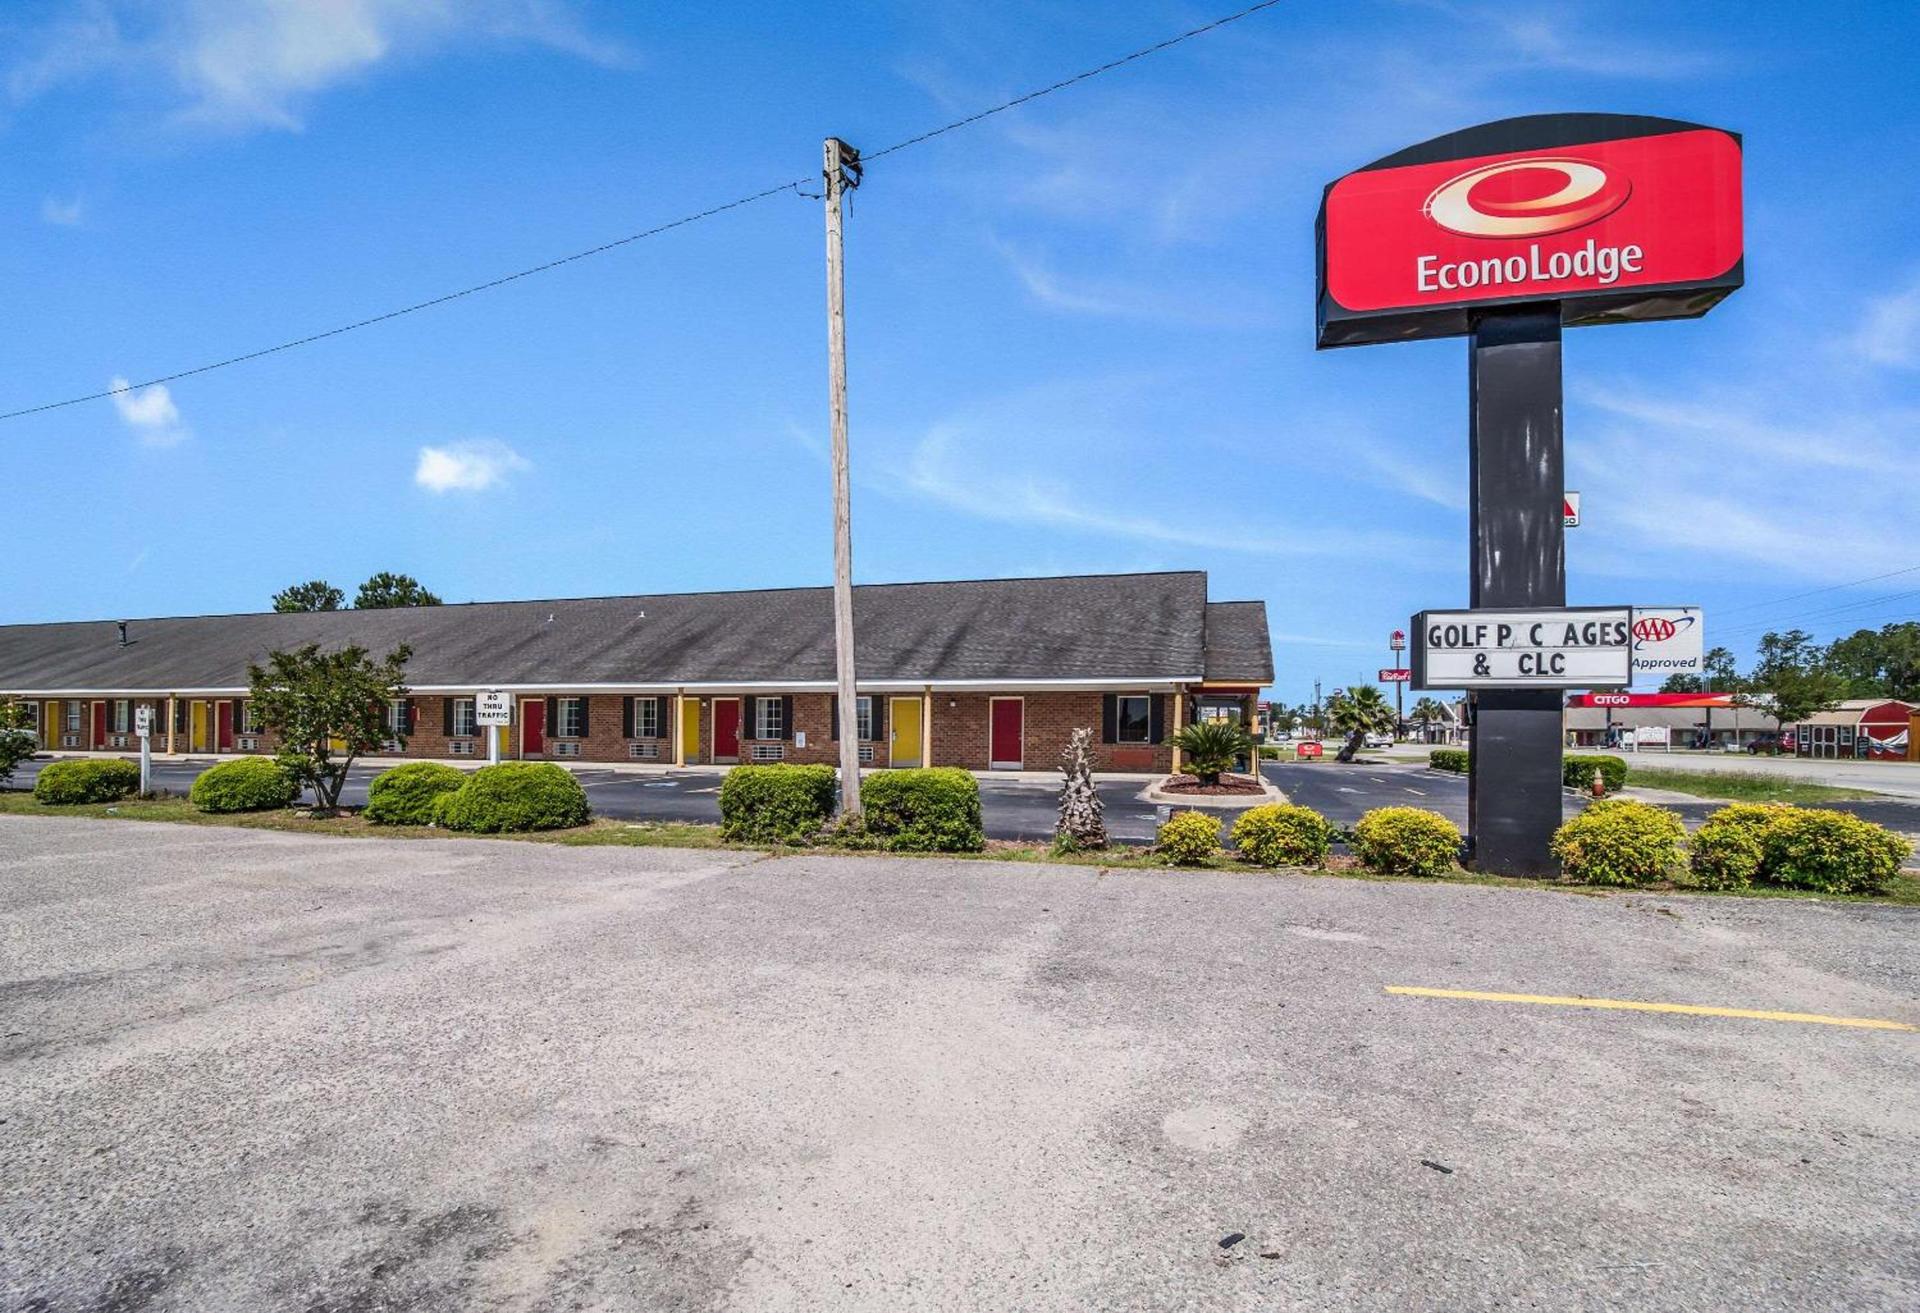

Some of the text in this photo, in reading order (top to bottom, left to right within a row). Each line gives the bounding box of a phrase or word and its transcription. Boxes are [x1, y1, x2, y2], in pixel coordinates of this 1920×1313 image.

[1428, 624, 1487, 647] GOLF
[1635, 618, 1673, 641] AAA
[1472, 652, 1565, 675] & CLC
[1632, 657, 1697, 670] Approved
[1594, 695, 1629, 705] CITGO
